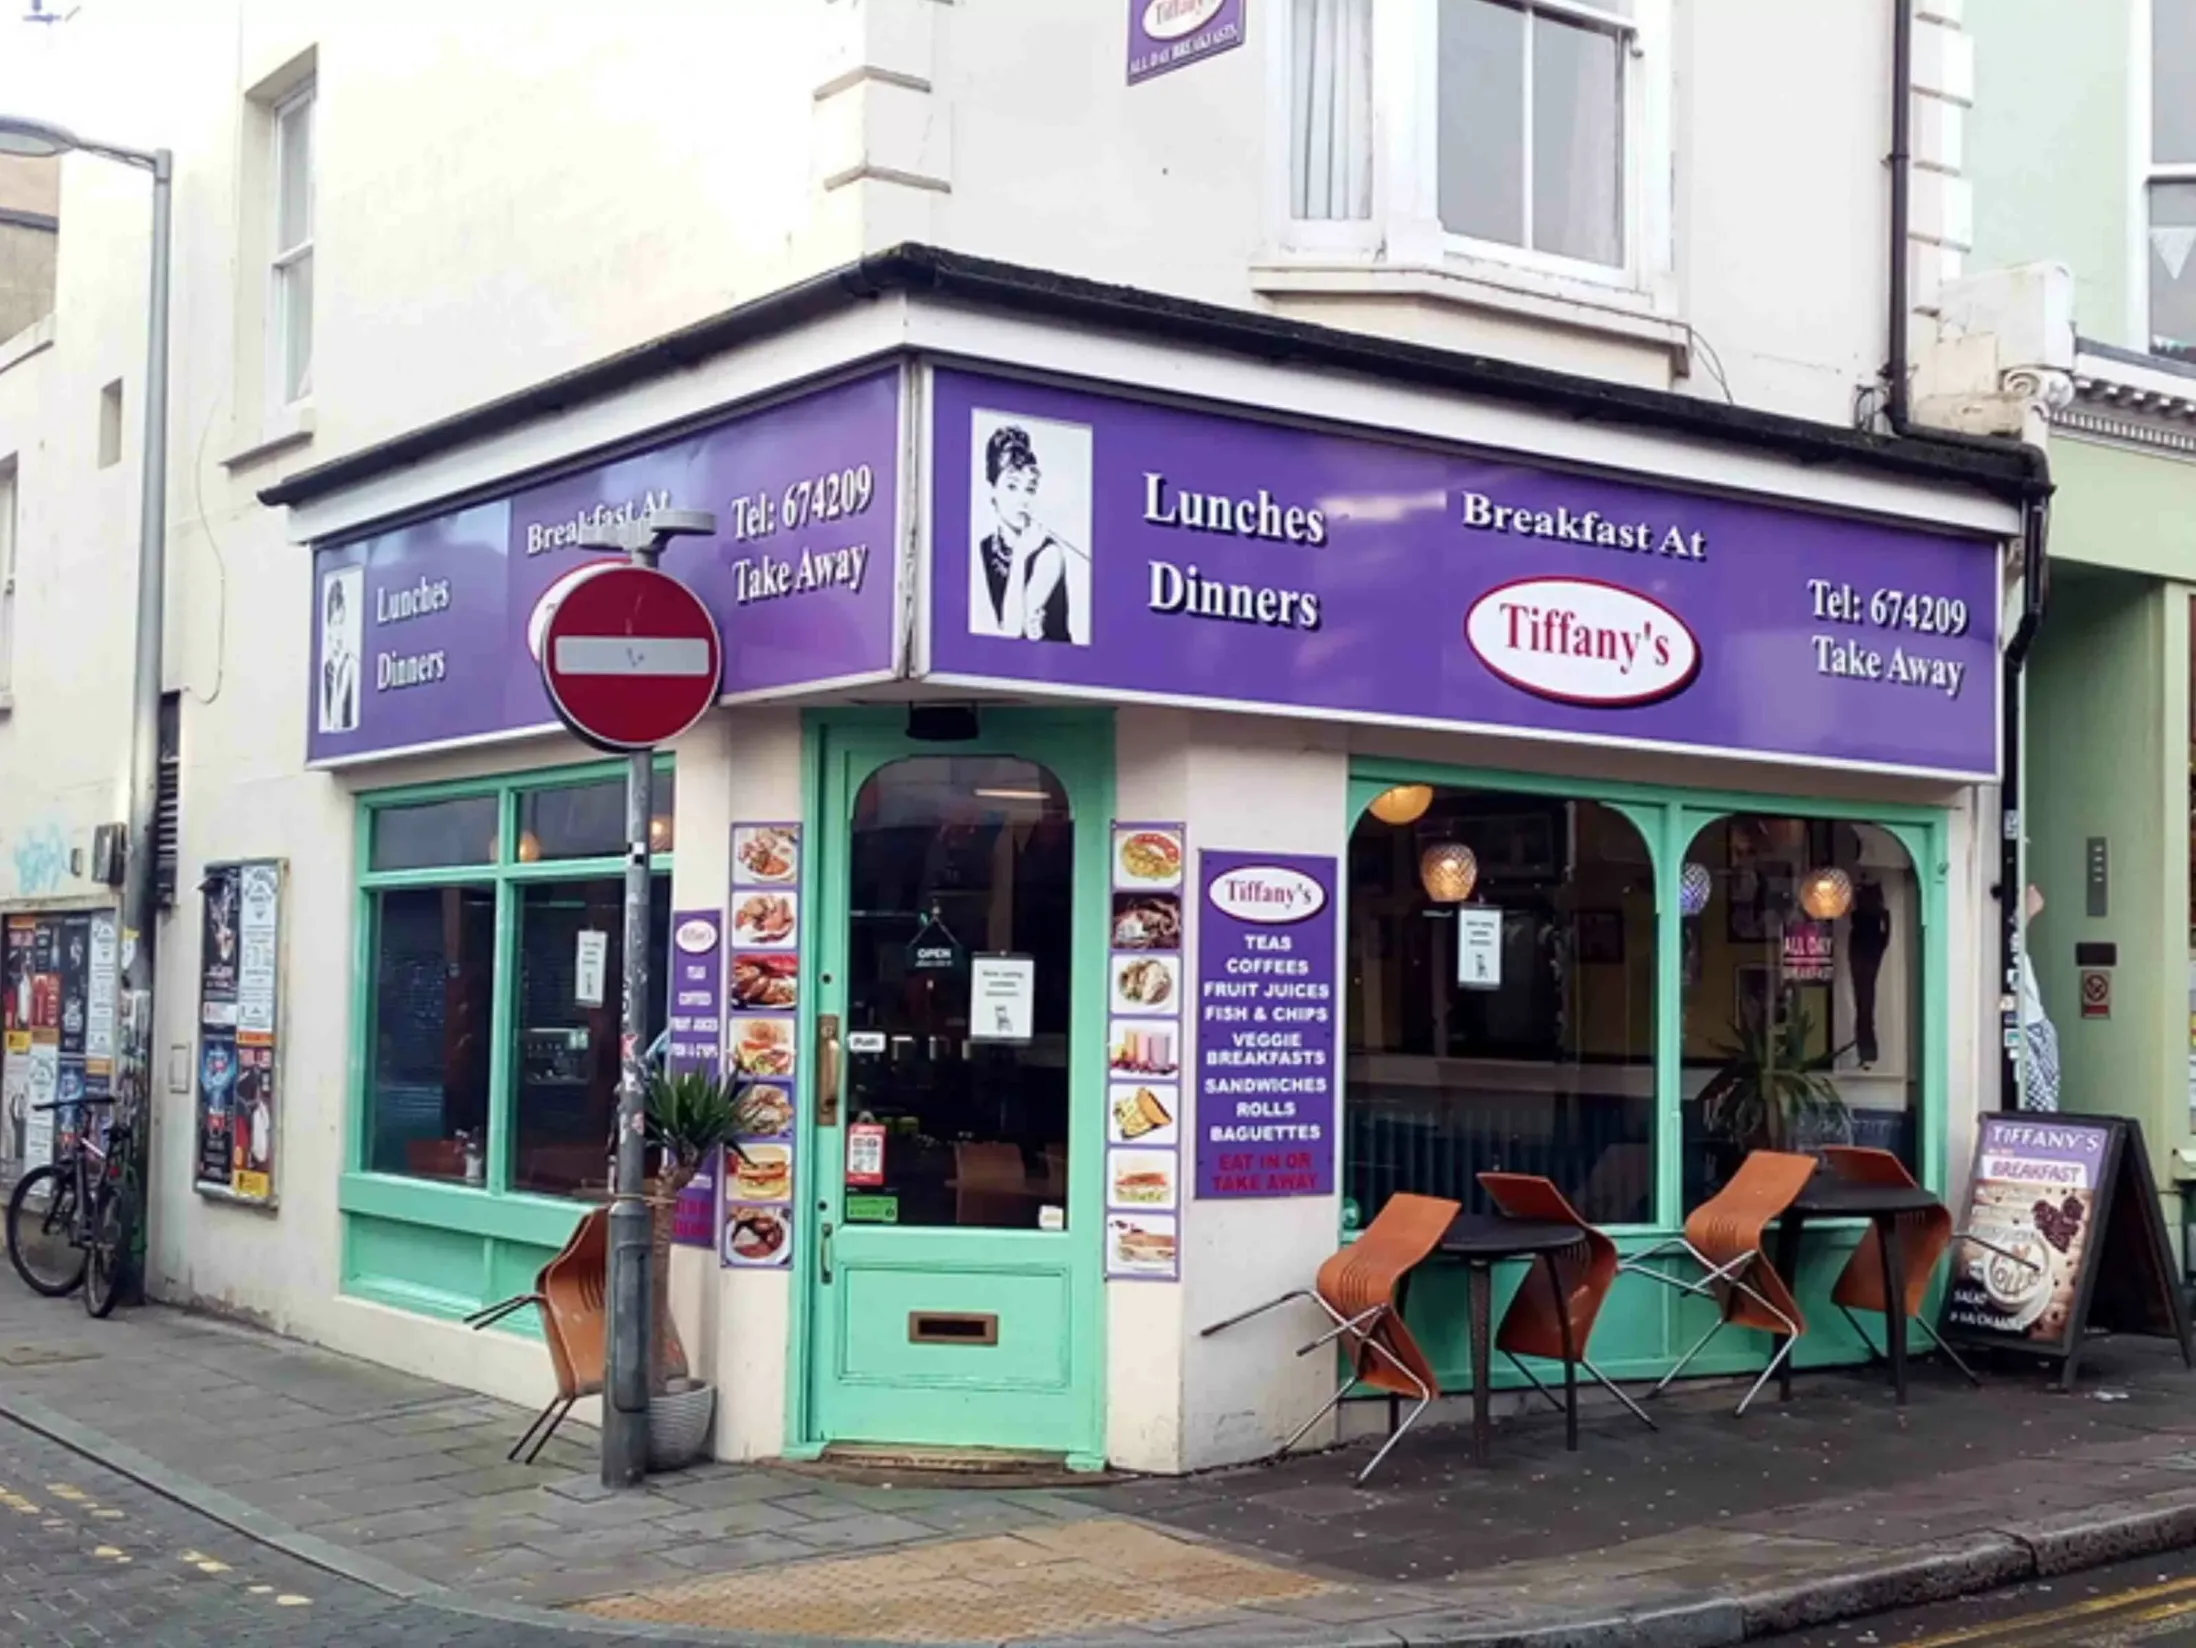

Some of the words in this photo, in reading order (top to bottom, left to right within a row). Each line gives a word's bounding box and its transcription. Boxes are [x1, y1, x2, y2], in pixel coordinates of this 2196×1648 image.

[731, 492, 776, 541] Tel:
[782, 463, 874, 530] 674209
[1142, 471, 1327, 545] Lunches
[1462, 490, 1653, 552] Breakfast
[1658, 525, 1707, 561] At
[731, 556, 792, 605] Take
[795, 543, 869, 594] Away
[377, 575, 451, 626] Lunches
[1147, 559, 1322, 632] Dinners
[1807, 578, 1863, 625] Tel:
[1870, 588, 1970, 636] 674209
[1499, 602, 1671, 675] Tiffany's
[377, 649, 446, 692] Dinners
[1812, 634, 1883, 682] Take
[1887, 645, 1964, 700] Away
[1225, 879, 1313, 911] Tiffany's
[1244, 933, 1293, 951] TEAS
[1226, 957, 1310, 976] COFFEES
[1203, 980, 1259, 998] FRUIT
[1263, 982, 1330, 999] JUICES
[1204, 1005, 1248, 1022] FISH
[1253, 1006, 1268, 1023] &
[1271, 1005, 1329, 1023] CHIPS
[1231, 1031, 1303, 1048] VEGGIE
[1205, 1050, 1327, 1067] BREAKFASTS
[1204, 1077, 1328, 1094] SANDWICHES
[1236, 1101, 1297, 1118] ROLLS
[1209, 1125, 1322, 1143] BAGUETTES
[1992, 1126, 2100, 1152] TIFFANY'S
[1218, 1154, 1254, 1171] EAT
[1260, 1153, 1281, 1169] IN
[1286, 1152, 1312, 1169] OR
[1991, 1161, 2081, 1184] BREAKFAST
[1212, 1175, 1260, 1191] TAKE
[1266, 1173, 1318, 1190] AWAY
